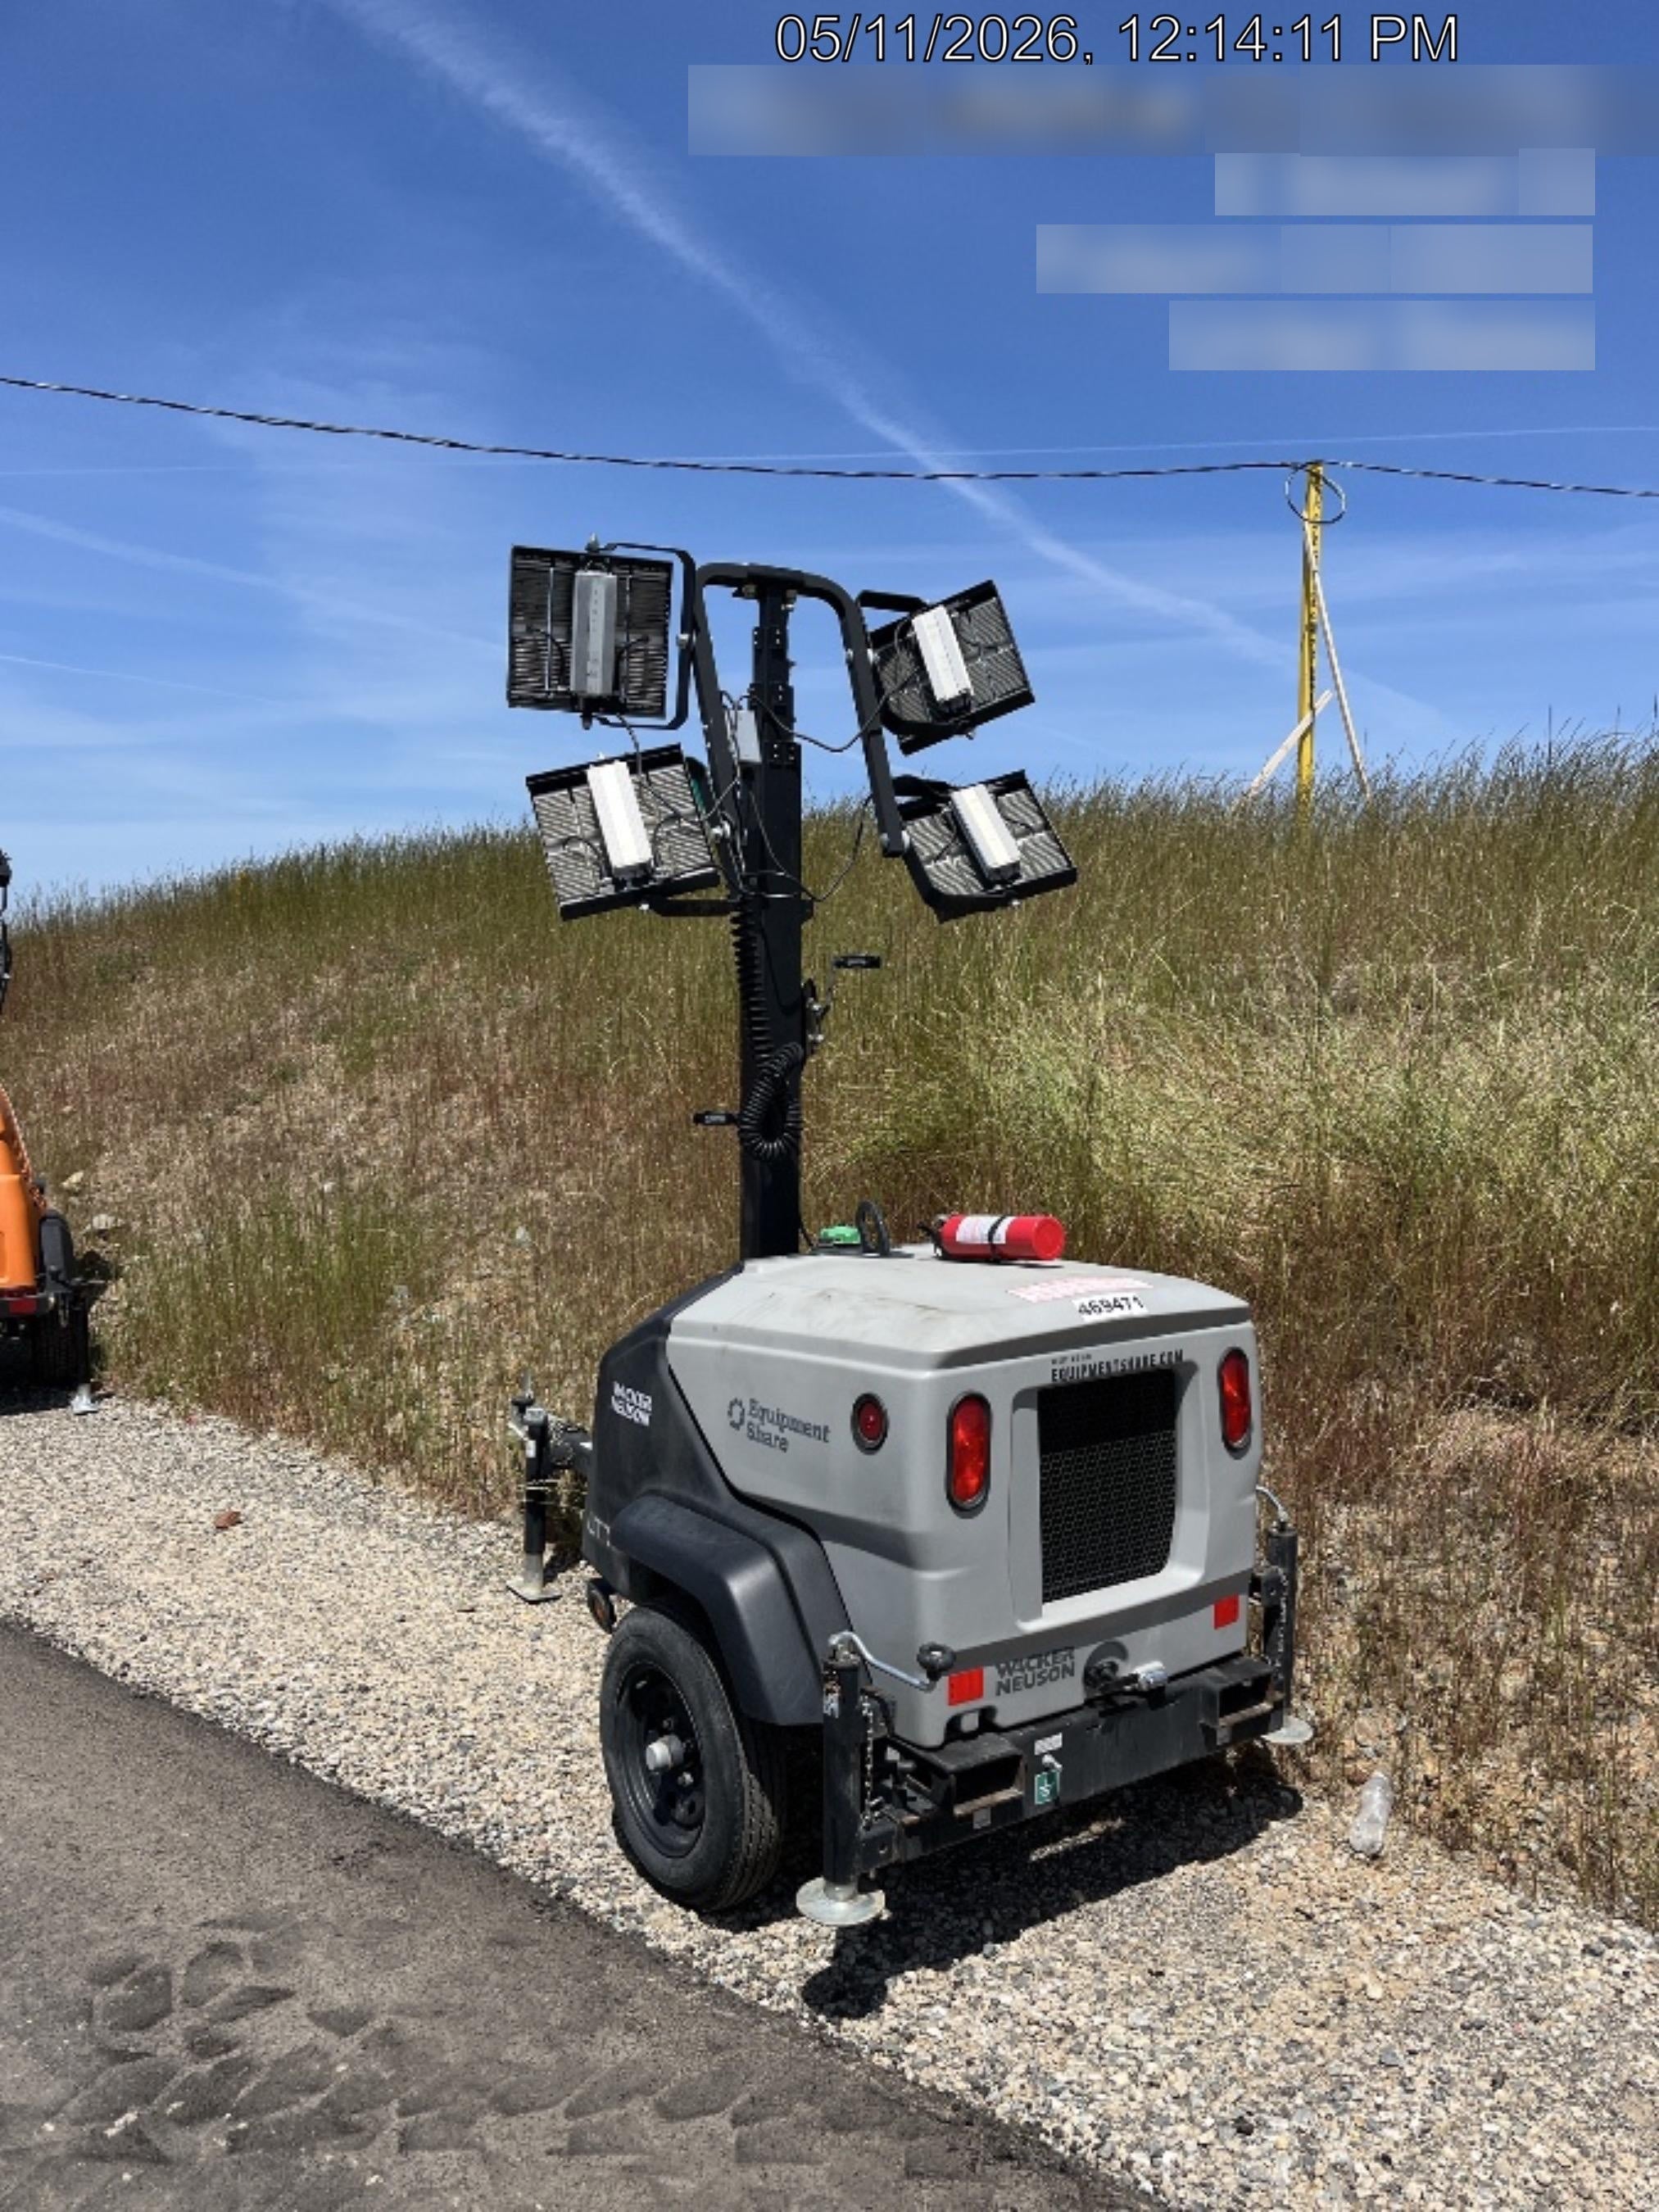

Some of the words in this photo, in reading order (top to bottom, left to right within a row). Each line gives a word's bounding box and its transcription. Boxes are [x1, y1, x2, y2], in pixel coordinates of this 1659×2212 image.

[746, 1421, 789, 1453] Share
[748, 1397, 831, 1444] Equipment
[995, 1647, 1075, 1679] WACKER
[995, 1661, 1075, 1697] NEUSON
